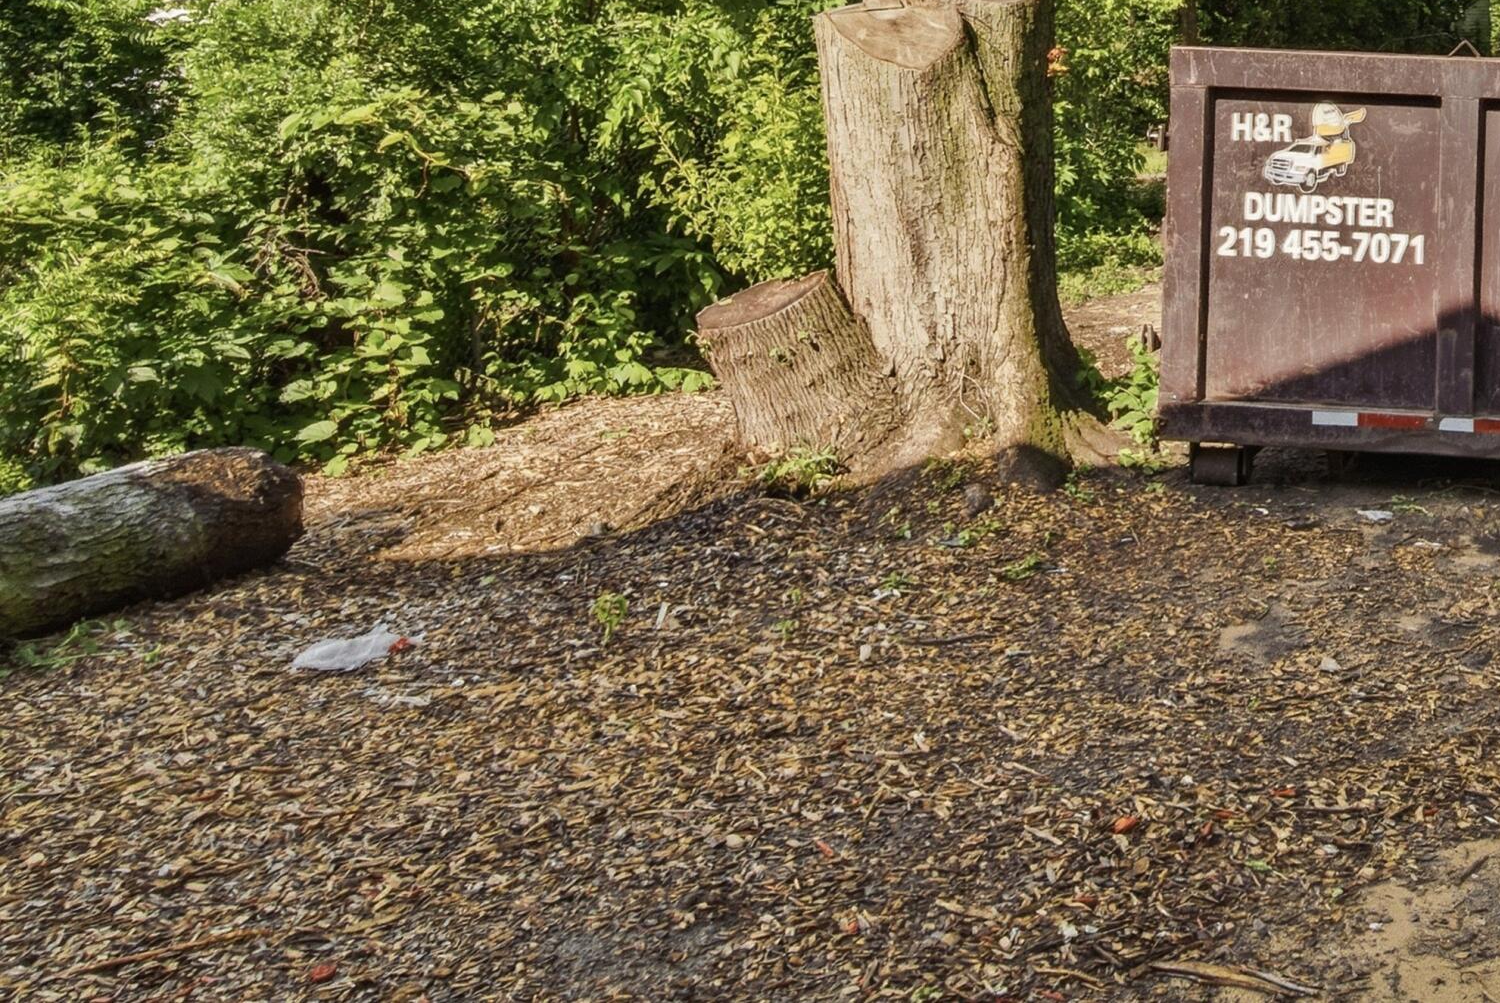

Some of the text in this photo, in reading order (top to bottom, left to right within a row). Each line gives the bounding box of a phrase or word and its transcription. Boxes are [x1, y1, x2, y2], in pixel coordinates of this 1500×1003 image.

[1231, 112, 1293, 142] H&R
[1243, 192, 1394, 228] DUMPSTER
[1217, 226, 1425, 265] 219 455-7071
